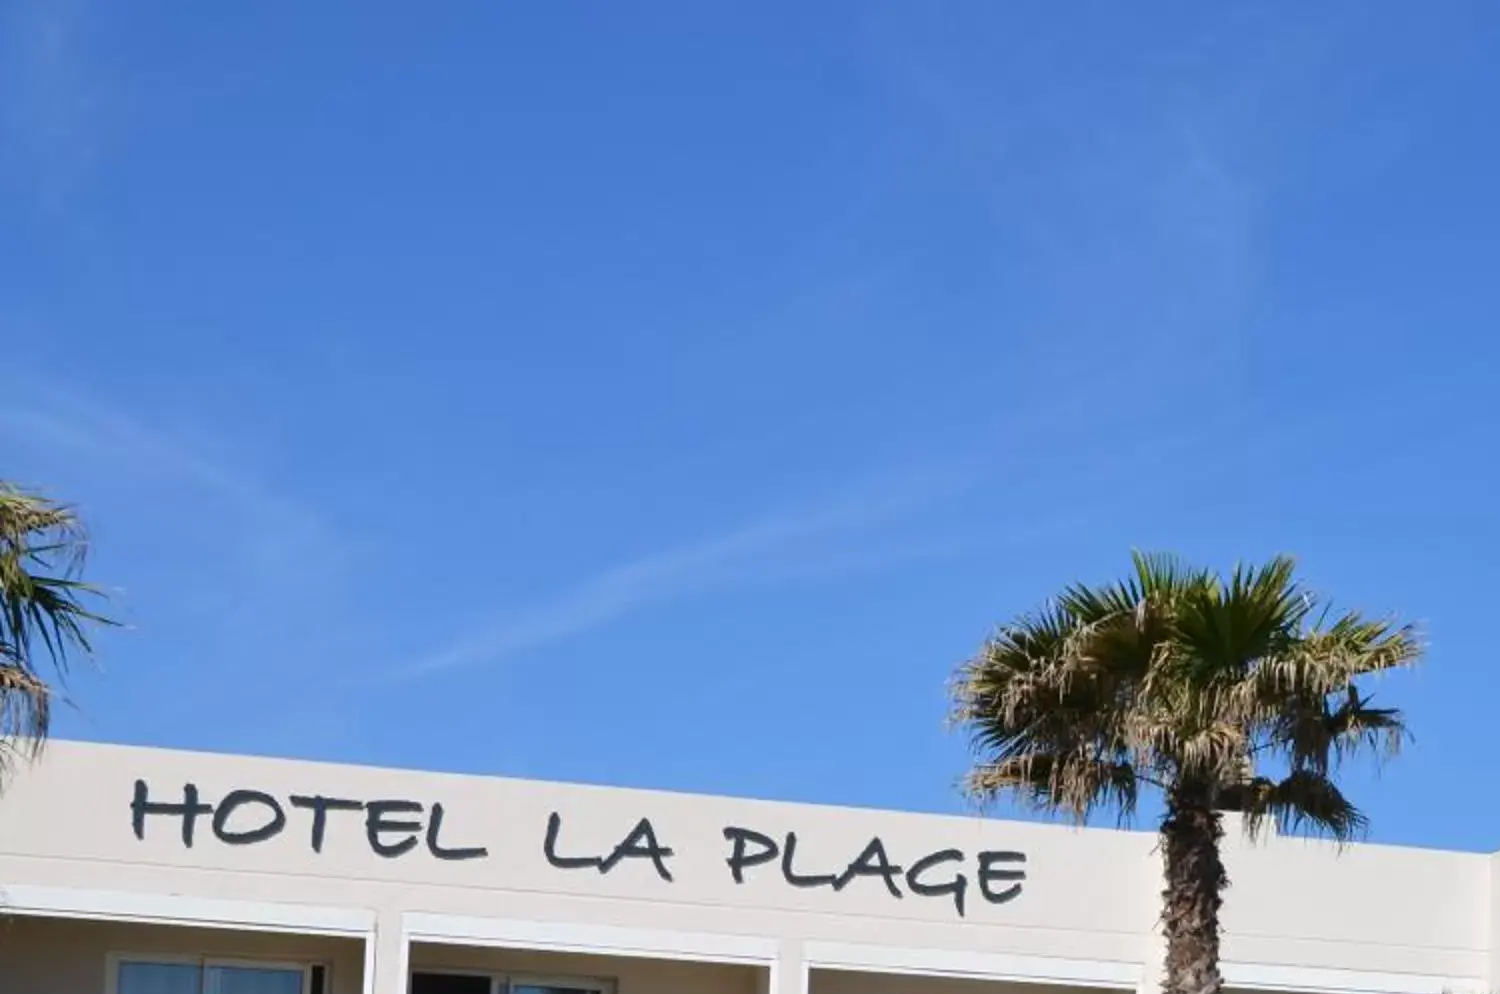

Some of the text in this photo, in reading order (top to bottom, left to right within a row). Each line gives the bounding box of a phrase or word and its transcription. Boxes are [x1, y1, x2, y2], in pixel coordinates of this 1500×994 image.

[130, 779, 1027, 917] HOTEL LA PLAGE
